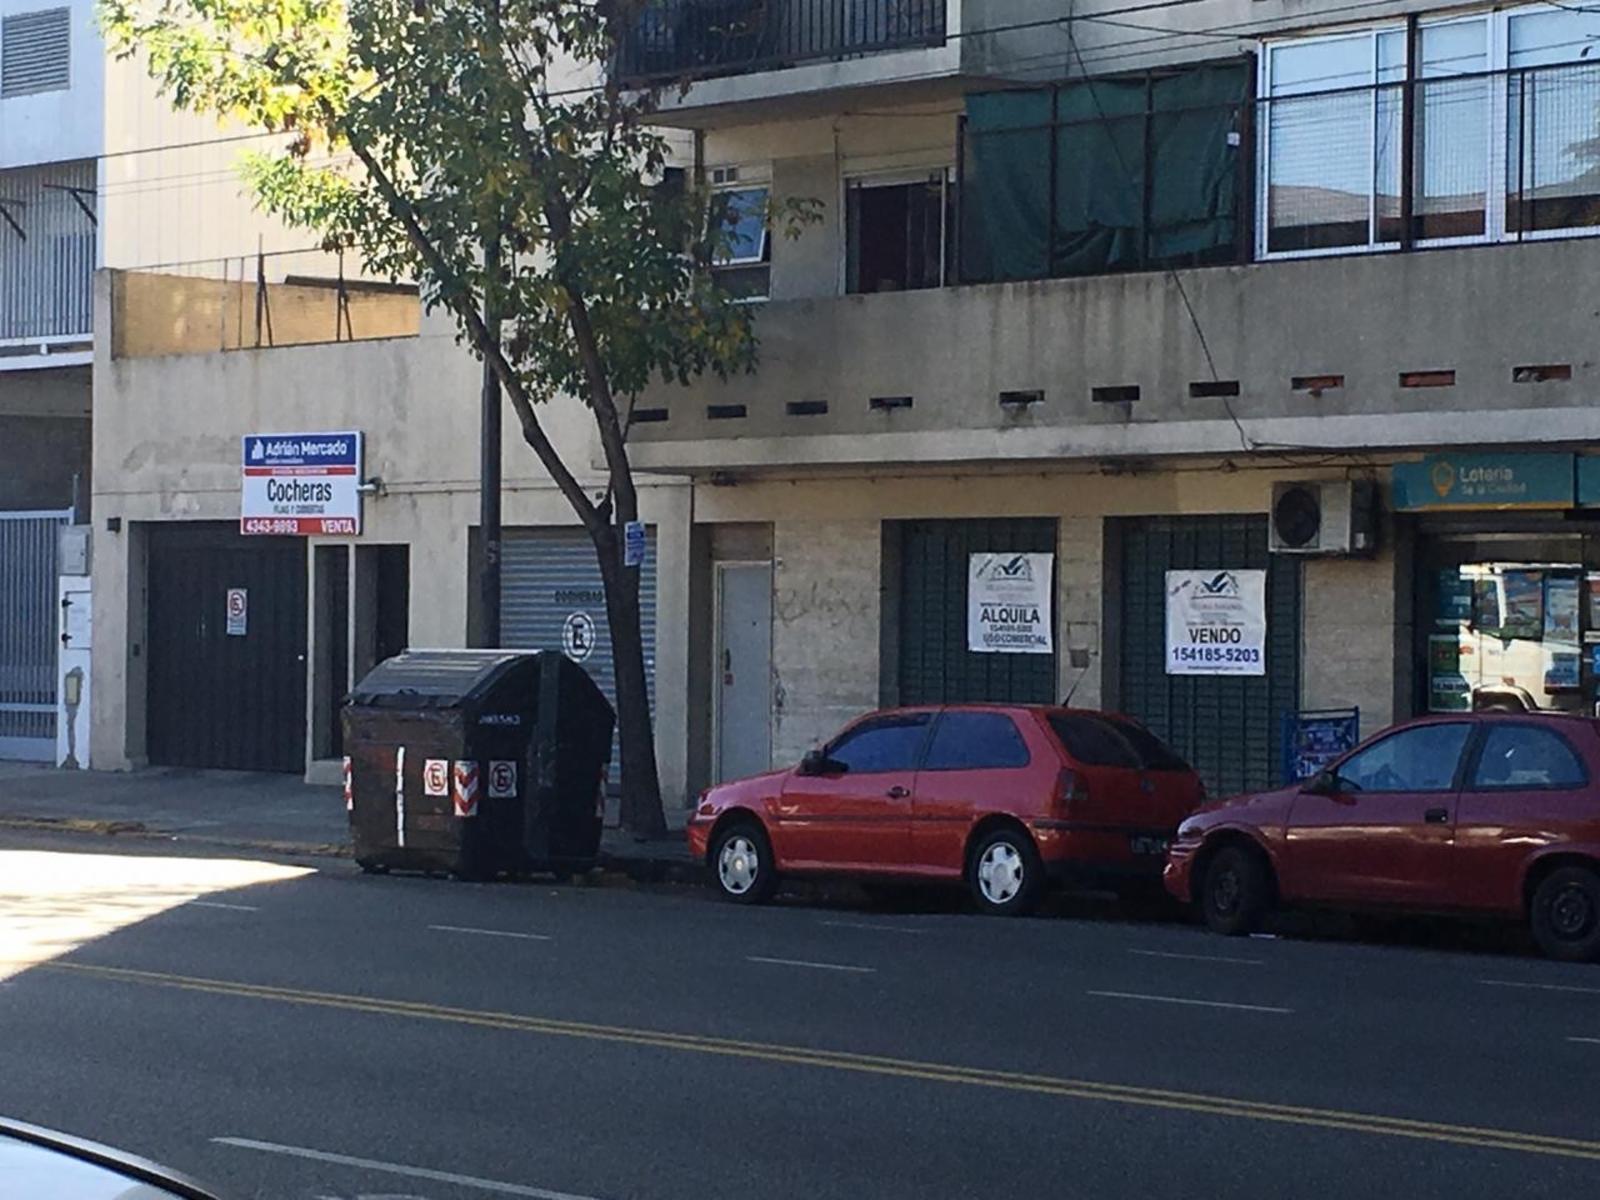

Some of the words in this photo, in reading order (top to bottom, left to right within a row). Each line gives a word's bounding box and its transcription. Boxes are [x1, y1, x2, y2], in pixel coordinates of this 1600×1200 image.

[301, 439, 348, 456] Mercado
[267, 478, 332, 501] Cocheras
[320, 519, 354, 533] VENTA
[980, 608, 1041, 624] ALQUILA
[1188, 627, 1242, 644] VENDO
[1172, 646, 1259, 663] 154185-5203
